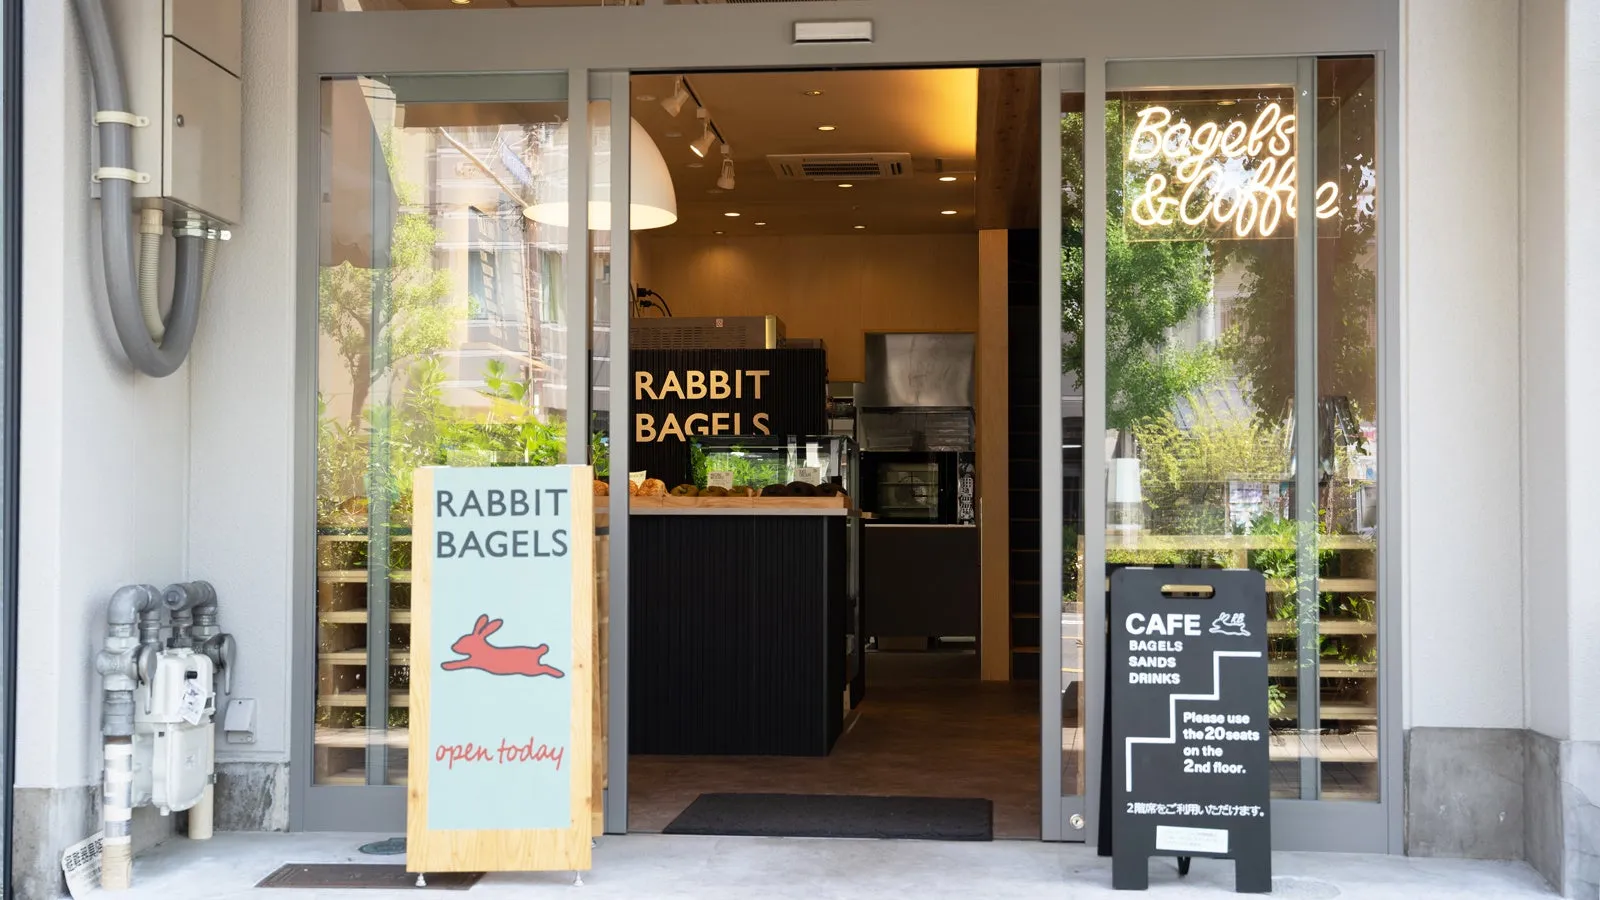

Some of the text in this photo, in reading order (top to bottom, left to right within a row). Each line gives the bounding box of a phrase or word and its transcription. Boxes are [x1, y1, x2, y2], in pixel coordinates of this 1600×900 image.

[1129, 102, 1296, 183] Bagels
[635, 369, 770, 400] RABBIT
[436, 488, 568, 518] RABBIT
[436, 529, 568, 559] BAGELS
[1125, 612, 1202, 636] CAFE
[1129, 640, 1184, 653] BAGELS
[1128, 655, 1177, 669] SANDS
[1128, 671, 1181, 685] DRINKS
[1183, 711, 1251, 725] Please use
[1182, 726, 1261, 742] the 20 seats
[435, 736, 565, 771] open today
[1183, 745, 1224, 757] on the
[1183, 759, 1247, 774] 2nd floor.
[1126, 802, 1265, 817] 2階席をご利用いただけます。
